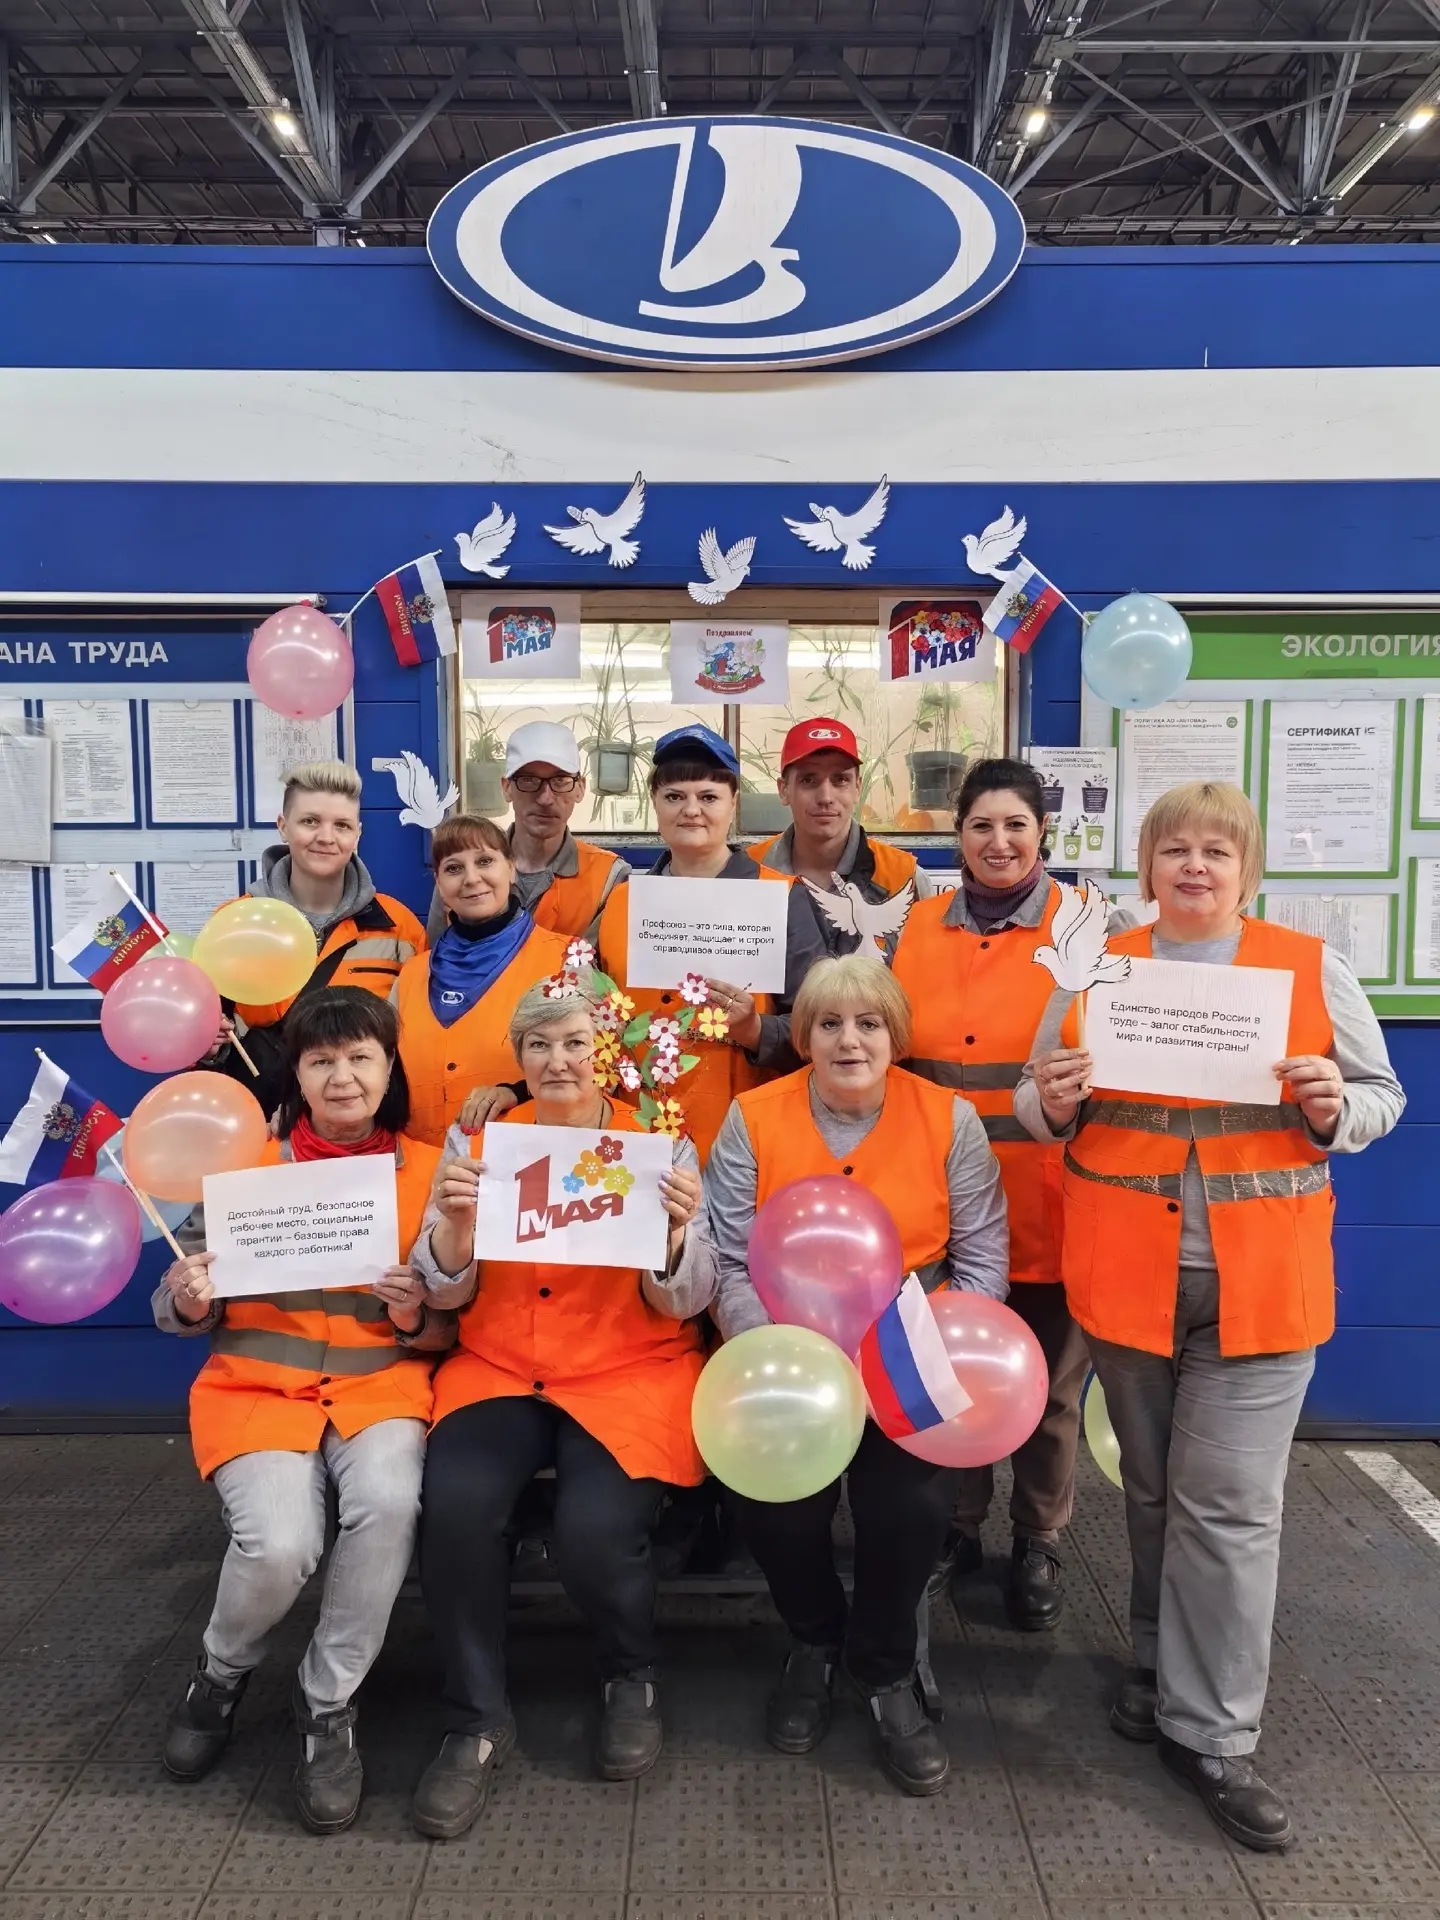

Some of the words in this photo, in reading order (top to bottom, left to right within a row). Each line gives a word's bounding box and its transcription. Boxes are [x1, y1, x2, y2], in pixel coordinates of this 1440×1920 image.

[394, 594, 410, 635] РОССИЯ
[487, 621, 503, 663] 1
[507, 631, 551, 659] МАЯ
[888, 618, 910, 680] 1
[914, 634, 976, 674] МАЯ
[68, 641, 169, 667] ТРУДА
[1287, 727, 1361, 737] СЕРТИФИКАТ
[642, 919, 687, 929] Профсоюз
[712, 923, 735, 932] сила,
[737, 925, 772, 933] которая
[638, 931, 690, 942] объединяет,
[692, 936, 736, 944] защищает
[746, 938, 775, 946] строит
[715, 947, 759, 957] общество!
[1110, 1001, 1161, 1015] Единство
[1163, 1008, 1209, 1020] народов
[1212, 1011, 1251, 1024] России
[1108, 1016, 1138, 1029] труде
[1150, 1021, 1180, 1031] залог
[1182, 1024, 1260, 1040] стабильности,
[1116, 1032, 1142, 1043] мира
[1155, 1036, 1204, 1048] развития
[1206, 1041, 1250, 1052] страны!
[514, 1154, 551, 1243] 1
[228, 1206, 285, 1221] Достойный
[288, 1204, 313, 1215] труд,
[316, 1199, 374, 1211] безопасное
[518, 1191, 624, 1237] МАЯ
[230, 1220, 274, 1235] рабочее
[276, 1218, 309, 1229] место,
[312, 1213, 374, 1226] социальные
[236, 1234, 282, 1247] гарантии
[294, 1230, 337, 1241] базовые
[340, 1227, 369, 1238] права
[254, 1247, 295, 1259] каждого
[298, 1242, 353, 1256] работника!
